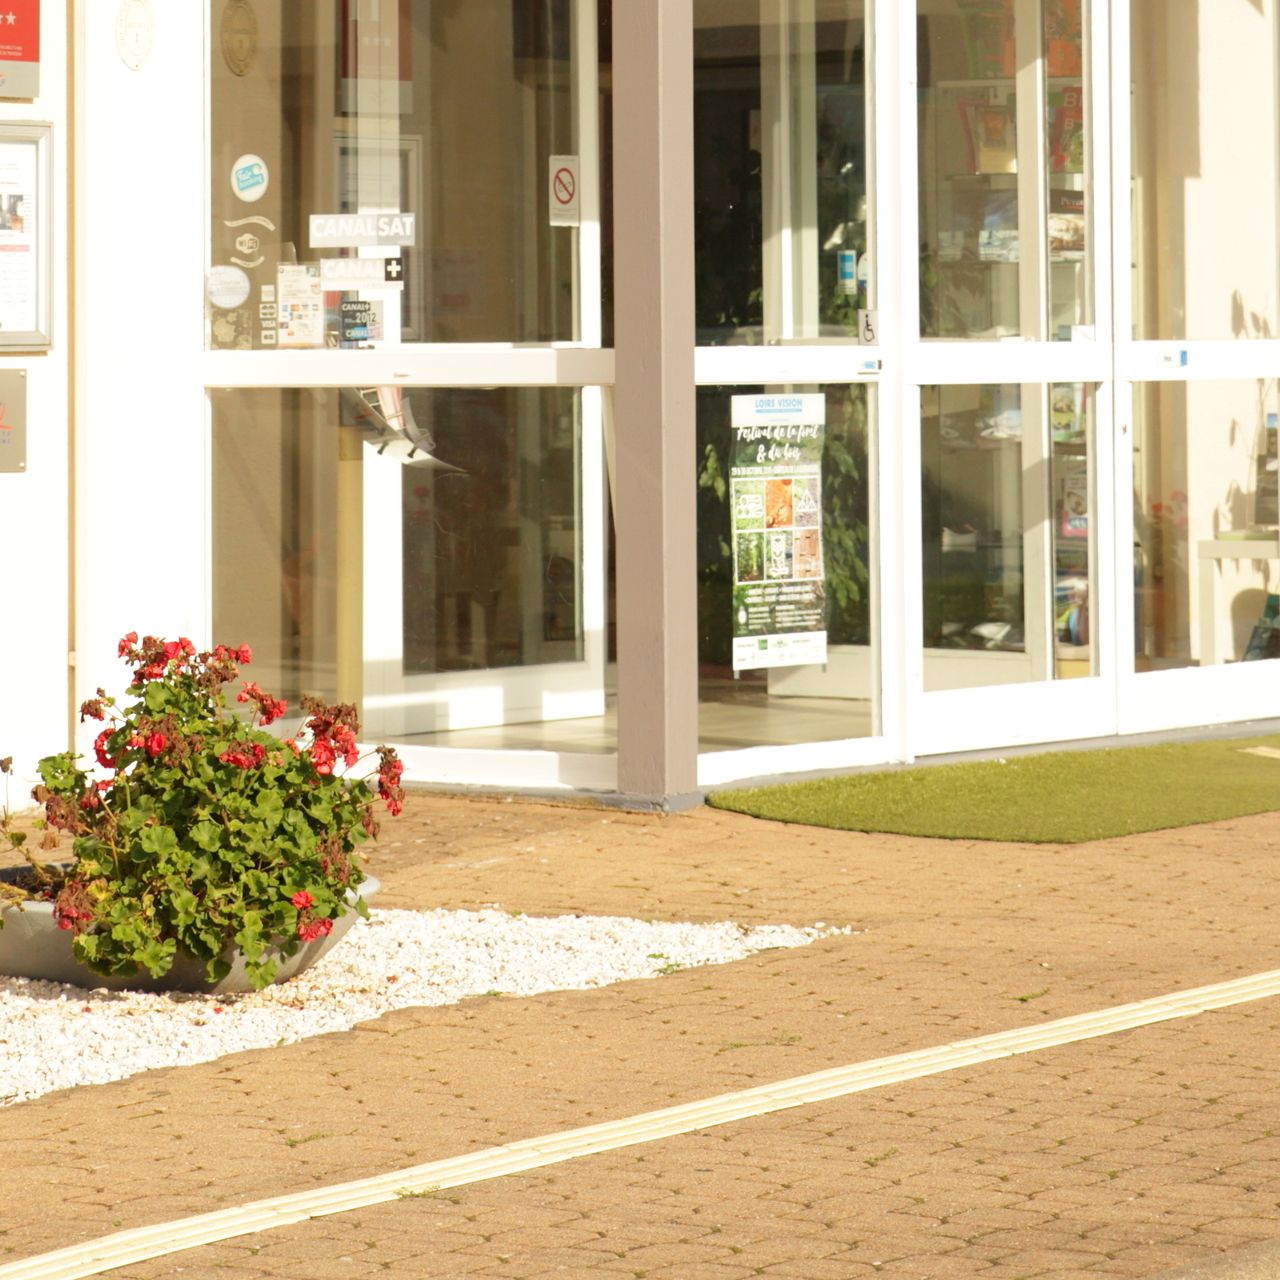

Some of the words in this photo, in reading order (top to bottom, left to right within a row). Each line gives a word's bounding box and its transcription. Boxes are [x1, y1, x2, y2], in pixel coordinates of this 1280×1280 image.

[312, 216, 414, 237] CANALSAT
[341, 303, 371, 311] CANAL+
[355, 312, 377, 323] 2012
[755, 399, 775, 407] LOIRE
[778, 398, 802, 407] VISION
[756, 444, 767, 463] &
